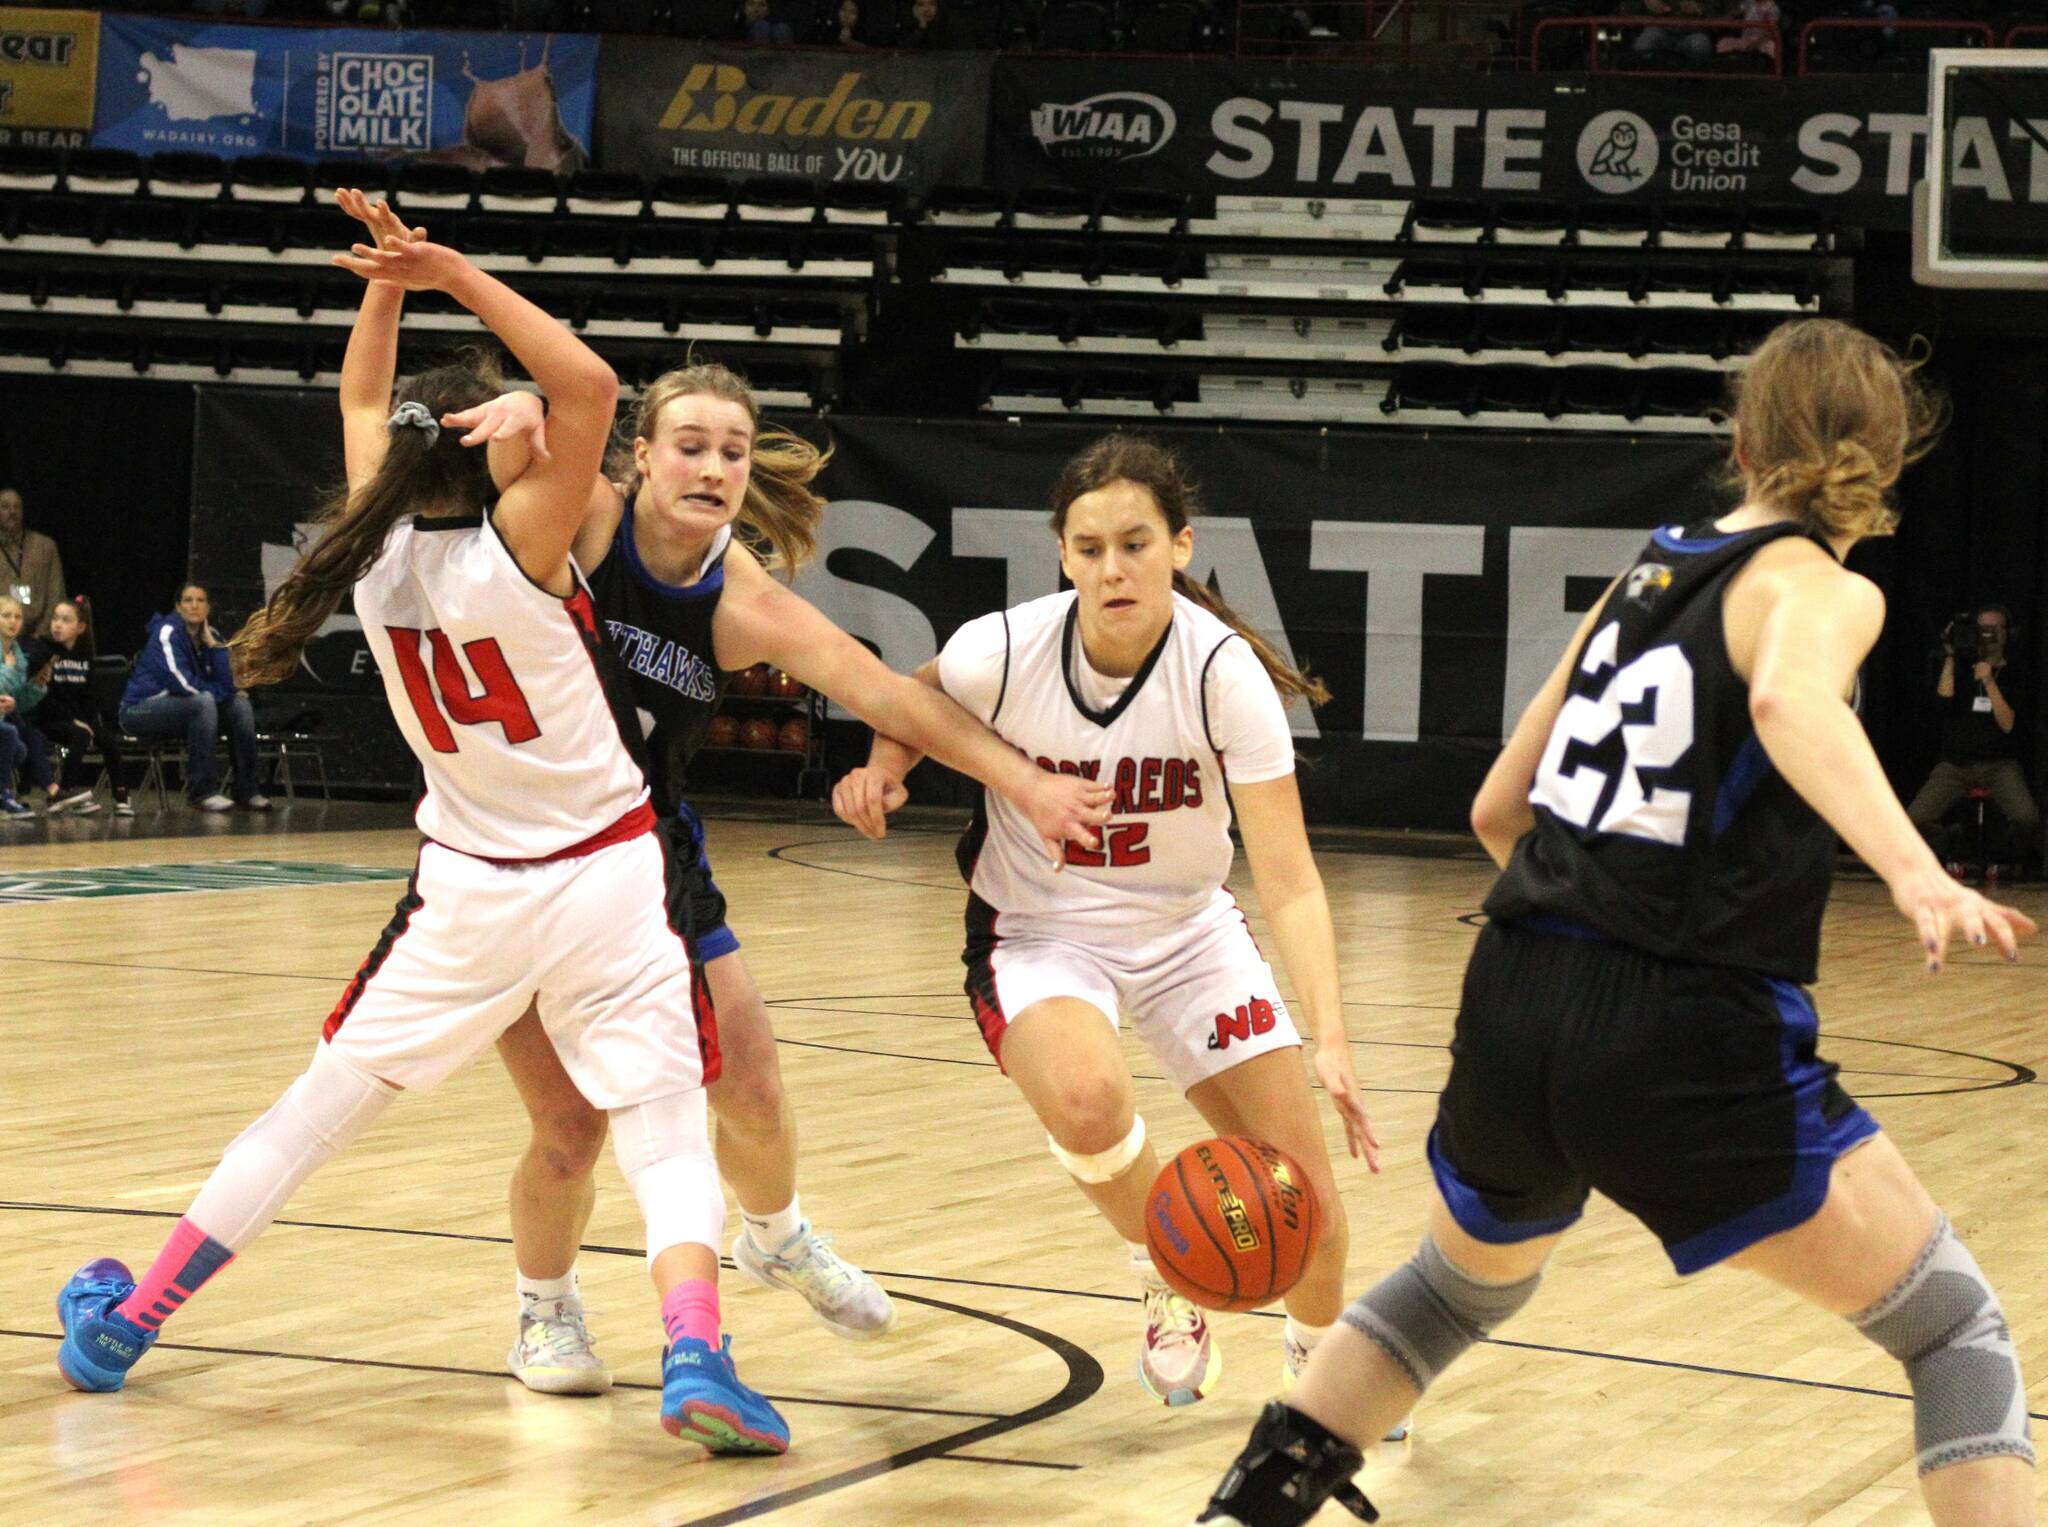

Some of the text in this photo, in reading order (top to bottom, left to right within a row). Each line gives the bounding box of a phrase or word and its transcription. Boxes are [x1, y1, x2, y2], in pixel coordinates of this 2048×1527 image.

[339, 60, 425, 94] CHOC
[314, 52, 331, 150] POWERED BY
[338, 84, 425, 118] OLATE
[658, 63, 932, 141] Baden
[21, 130, 83, 149] BEAR
[337, 116, 423, 146] MILK
[1050, 107, 1151, 143] WIAA
[1671, 114, 1742, 141] Gesa
[1204, 96, 1547, 191] STATE
[1671, 141, 1761, 167] Credit
[672, 147, 902, 183] THE OFFICIAL BALL OF YOU
[1670, 167, 1747, 191] Union
[385, 625, 542, 753] 14
[1528, 619, 1695, 847] 22
[1111, 756, 1203, 815] REDS
[1211, 998, 1277, 1049] NB
[1222, 1204, 1260, 1251] PRO
